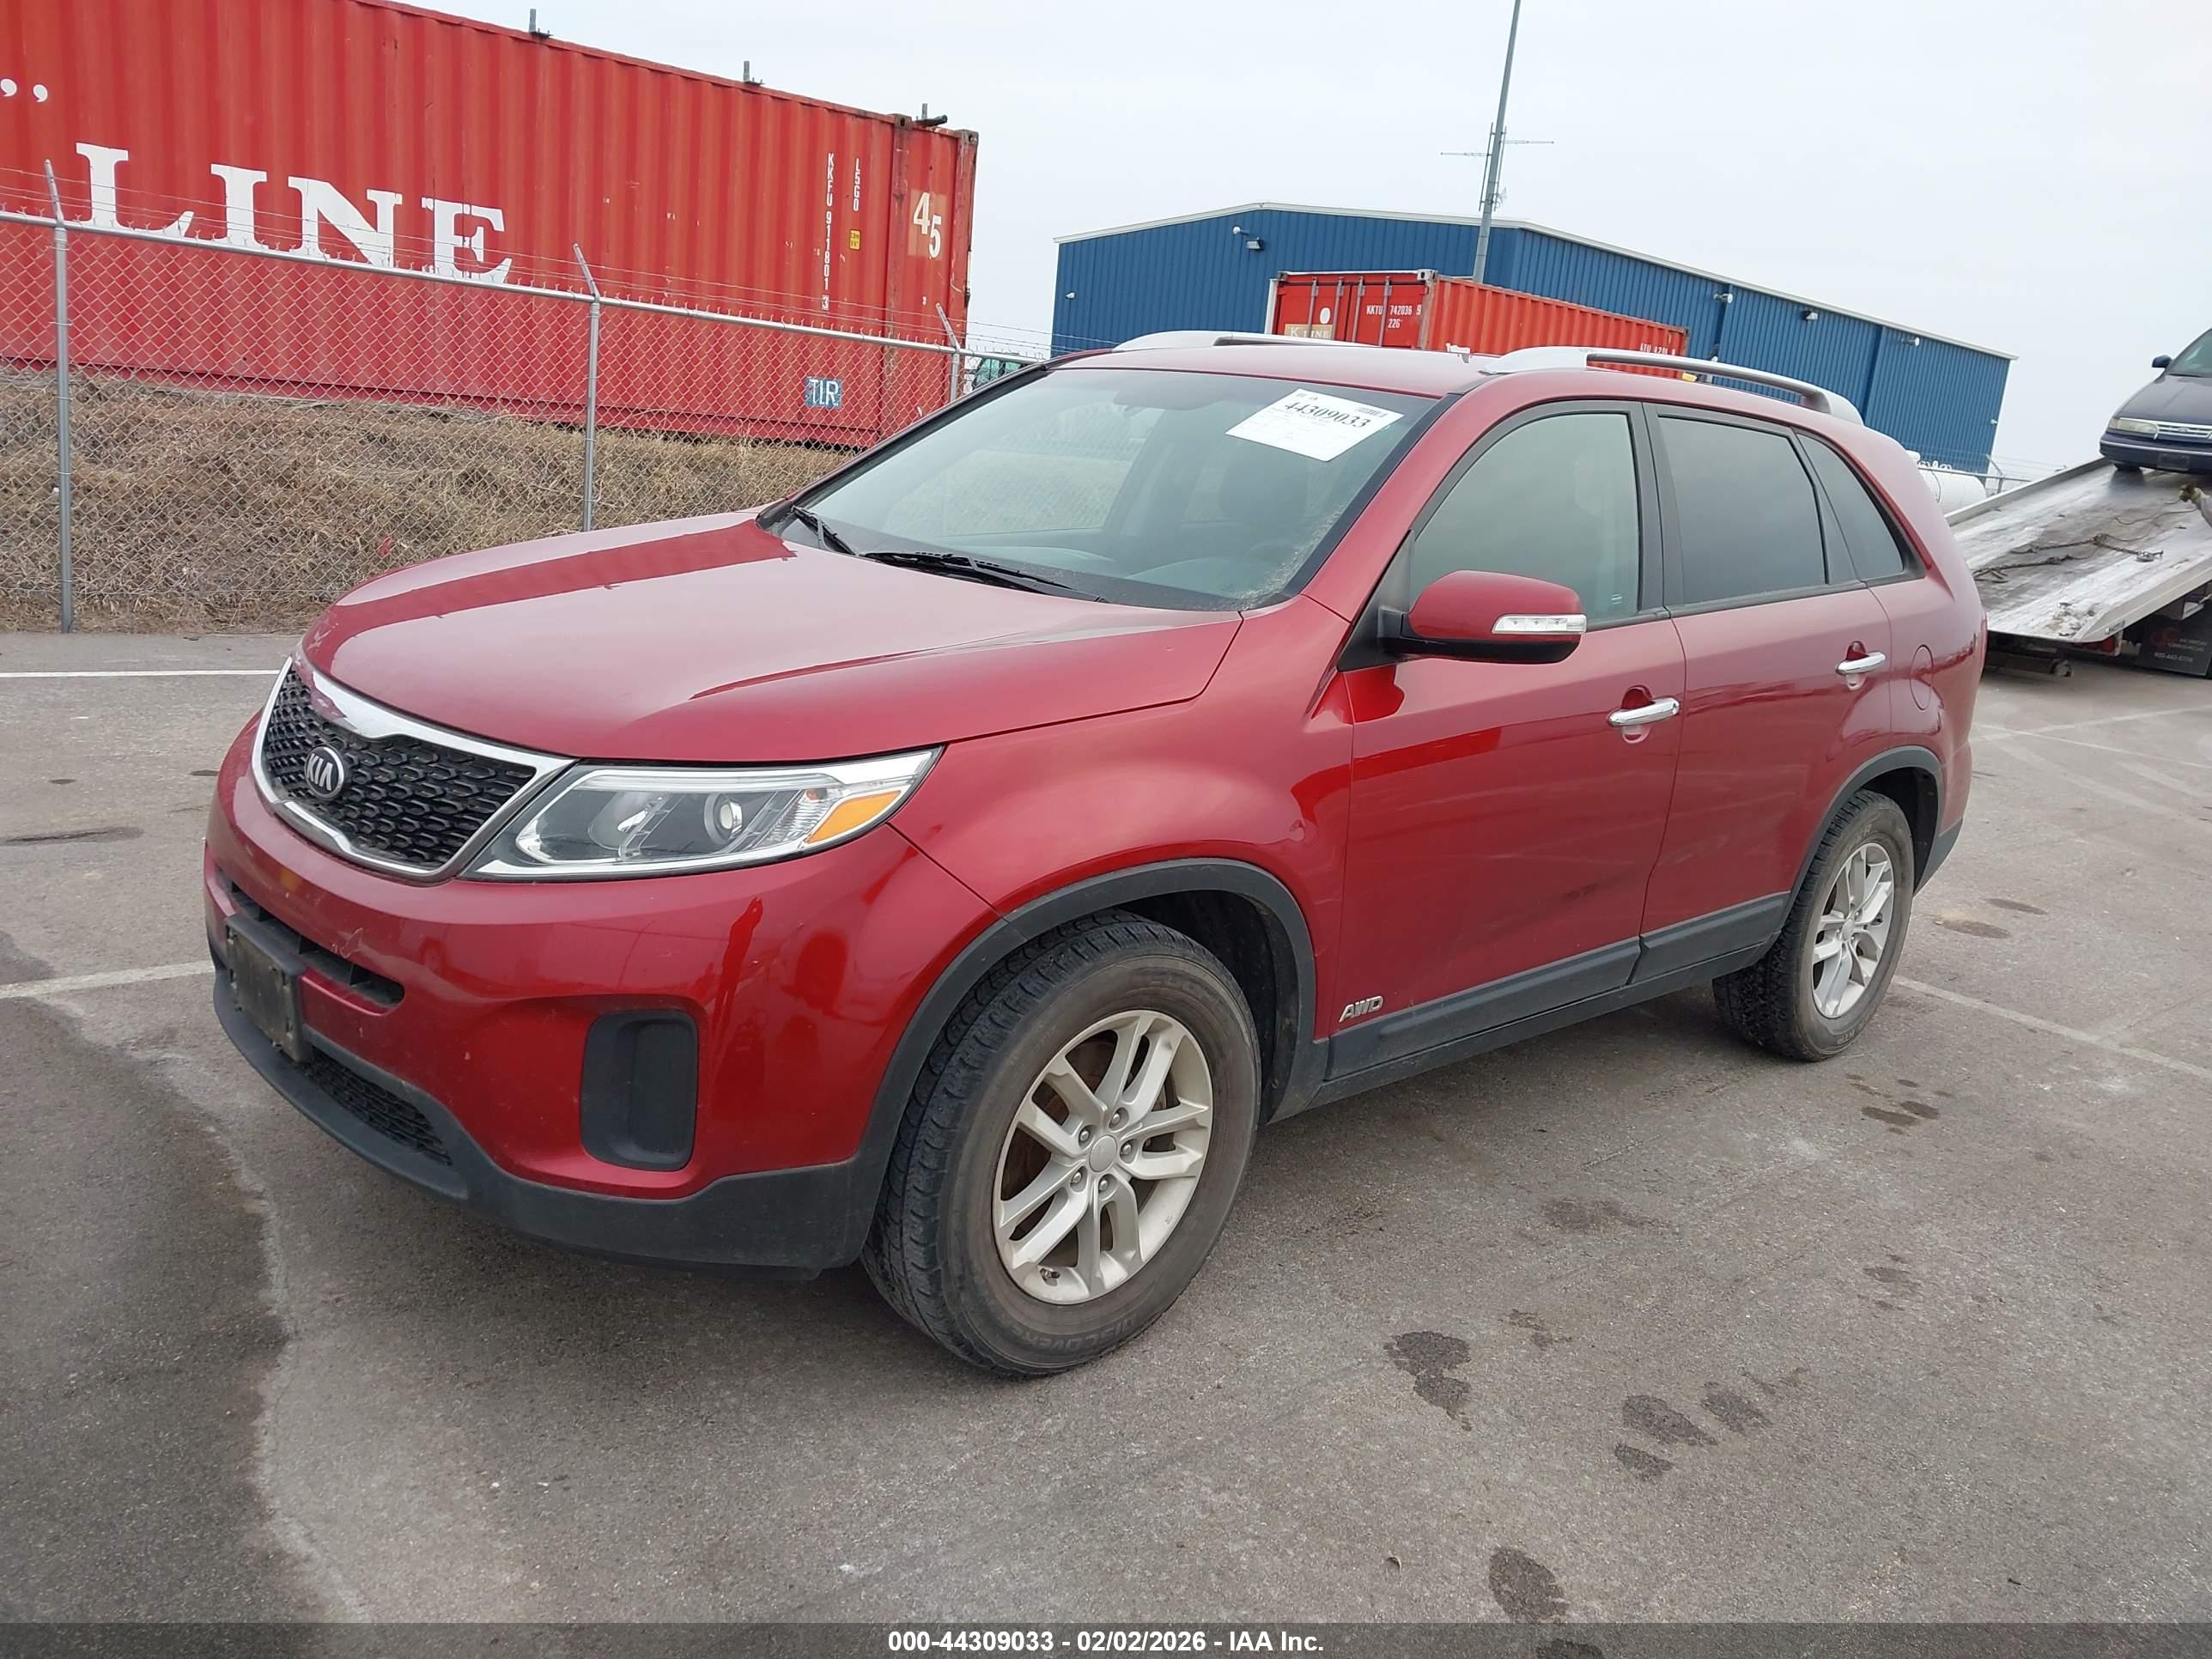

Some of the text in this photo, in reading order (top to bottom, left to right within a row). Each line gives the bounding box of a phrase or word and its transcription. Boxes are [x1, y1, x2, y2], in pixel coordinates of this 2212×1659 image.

[76, 142, 513, 284] LINE
[913, 191, 942, 258] 45
[1366, 304, 1382, 315] KKTU
[1389, 305, 1413, 316] 742036
[809, 379, 839, 406] TIR
[1285, 402, 1371, 428] 44309033
[307, 752, 333, 791] KIA
[1339, 995, 1383, 1023] AWD
